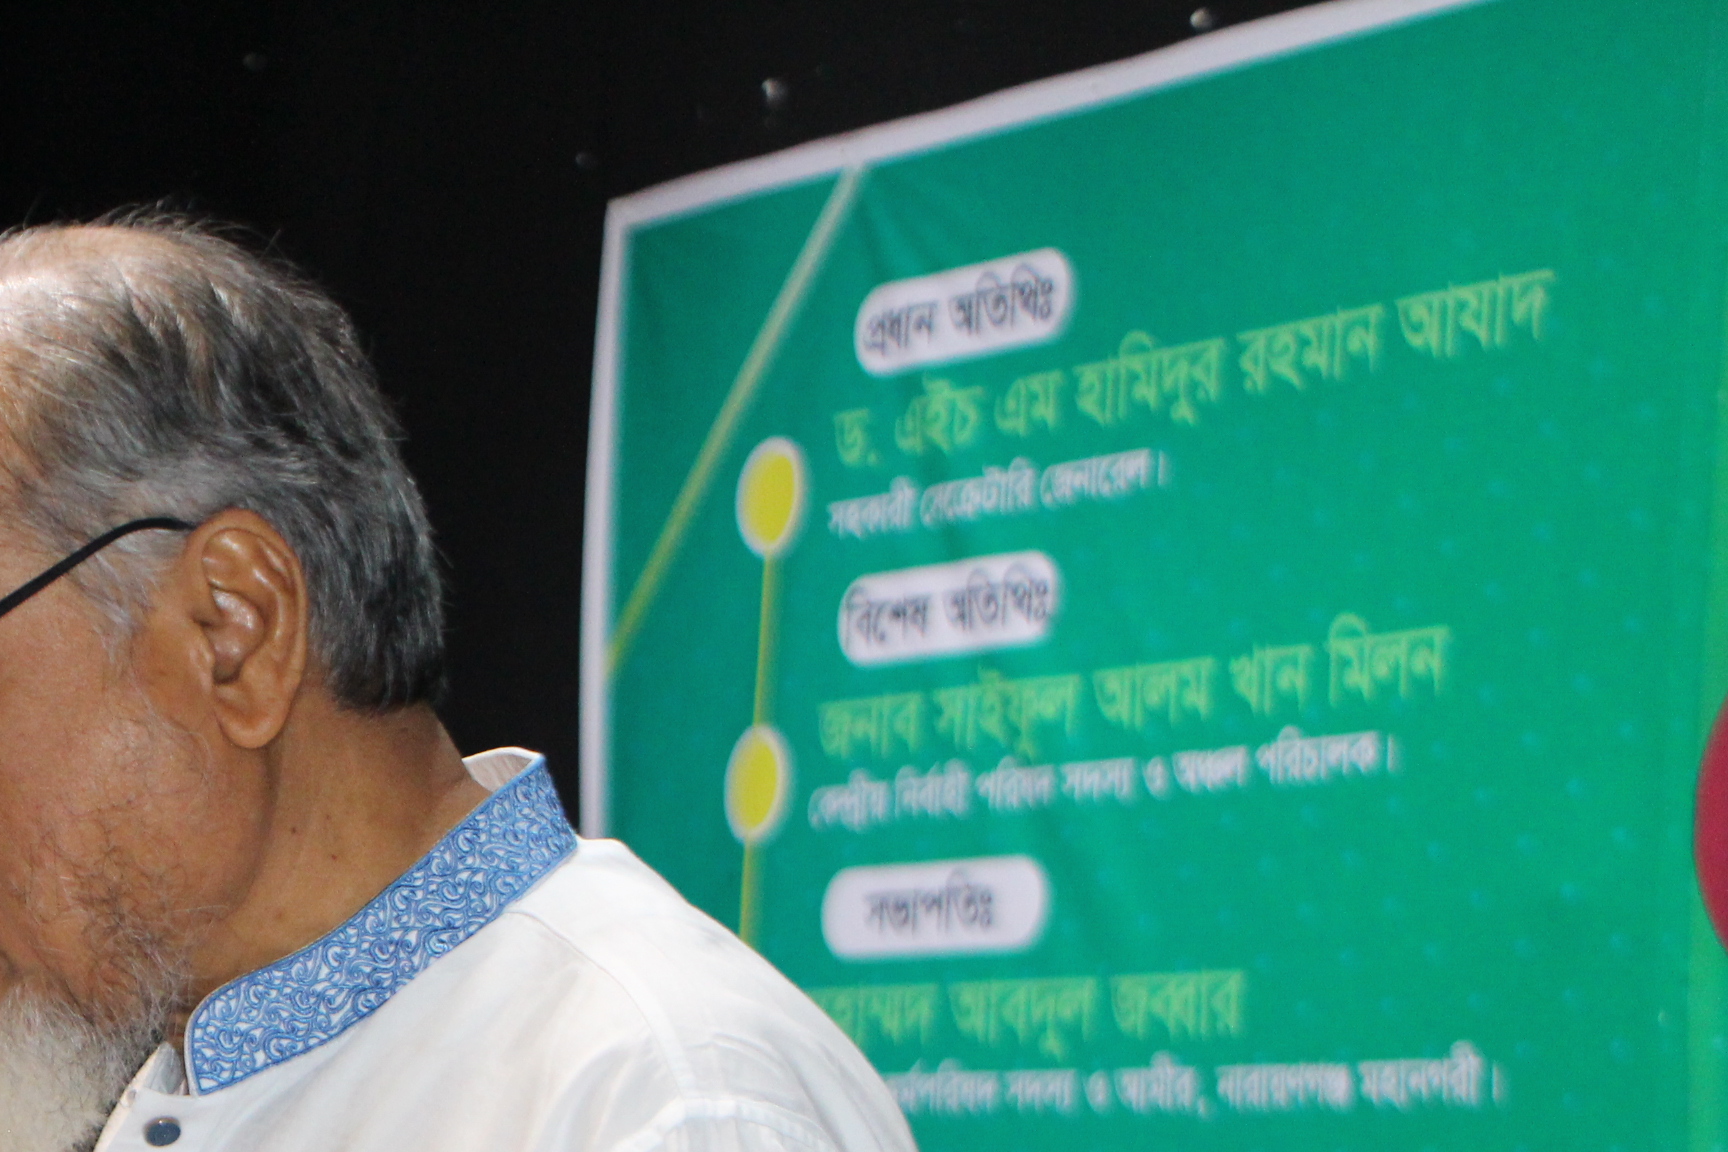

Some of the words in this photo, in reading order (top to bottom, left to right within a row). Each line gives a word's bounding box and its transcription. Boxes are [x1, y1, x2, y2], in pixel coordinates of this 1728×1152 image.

[865, 298, 940, 355] প্রধান
[948, 262, 1055, 336] অতিথিঃ
[894, 371, 986, 456] এইচ
[994, 369, 1065, 437] এম
[1073, 328, 1226, 428] হামিদুর
[1236, 303, 1383, 392] রহমান
[1394, 266, 1556, 358] আযাদ
[844, 583, 933, 646] বিশেষ
[943, 560, 1052, 634] অতিথিঃ
[930, 662, 1084, 766] সাইফুল
[1091, 655, 1216, 734] আলম
[1228, 642, 1314, 719] খান
[1322, 610, 1452, 709] মিলন
